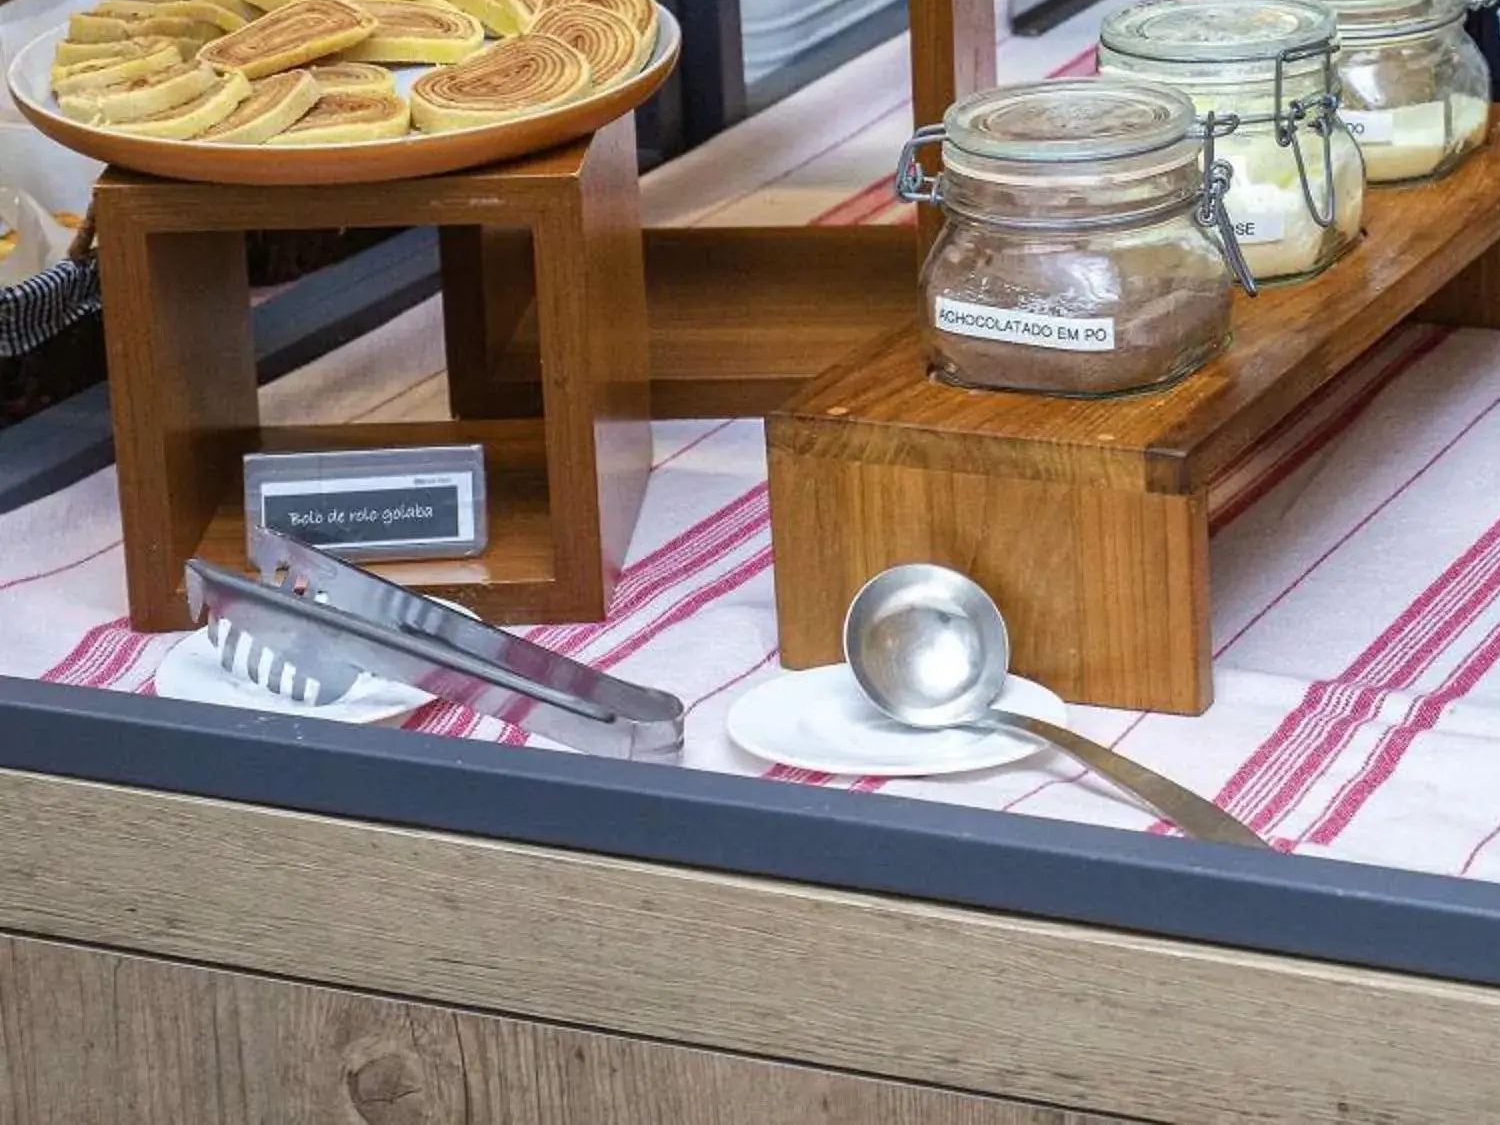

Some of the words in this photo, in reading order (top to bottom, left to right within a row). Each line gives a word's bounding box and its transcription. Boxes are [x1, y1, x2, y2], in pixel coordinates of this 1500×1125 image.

[939, 308, 1052, 338] ACHOCOLATADO
[1057, 326, 1079, 341] EM
[288, 510, 323, 526] Bolo
[327, 508, 345, 523] de
[349, 506, 377, 523] rolo
[381, 502, 433, 524] goiaba
